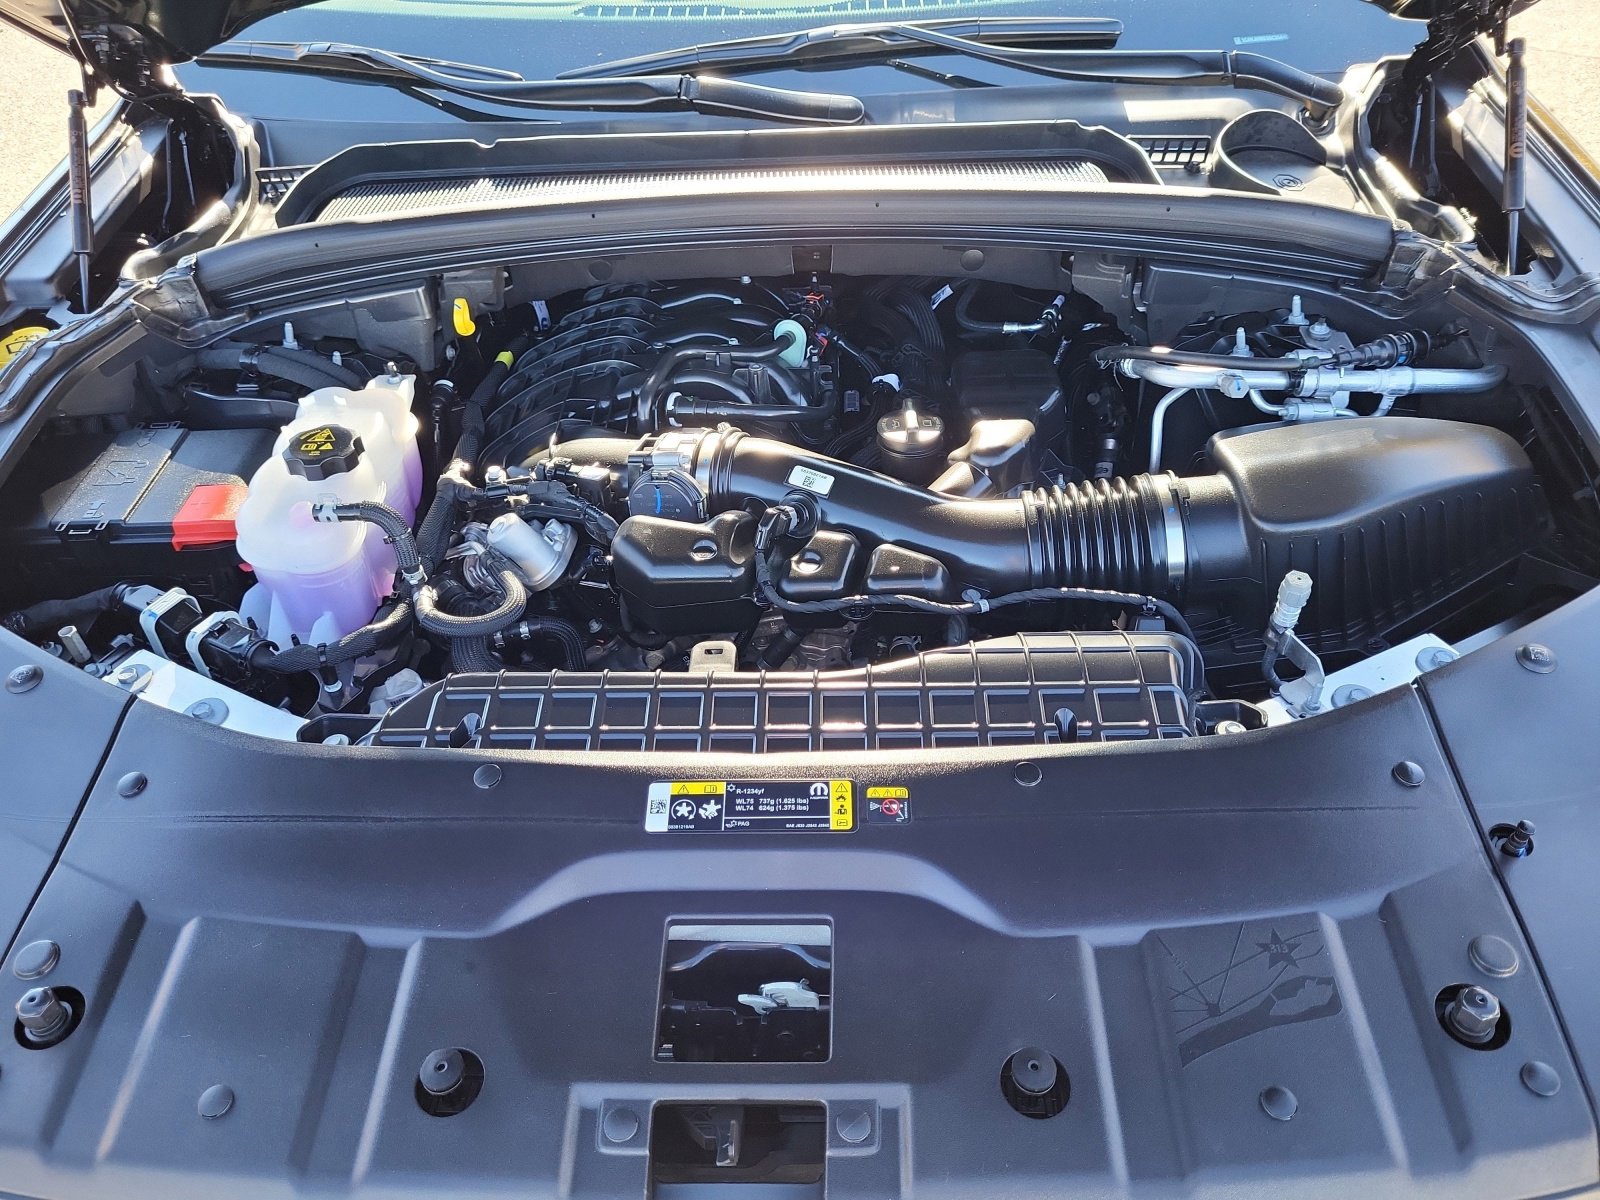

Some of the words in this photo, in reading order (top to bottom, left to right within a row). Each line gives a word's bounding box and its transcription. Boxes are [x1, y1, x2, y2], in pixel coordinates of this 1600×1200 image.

[758, 798, 775, 806] 737g
[775, 797, 796, 805] (1.625
[796, 797, 809, 805] lbs)
[796, 804, 809, 812] lbs)
[1270, 944, 1289, 953] 313
